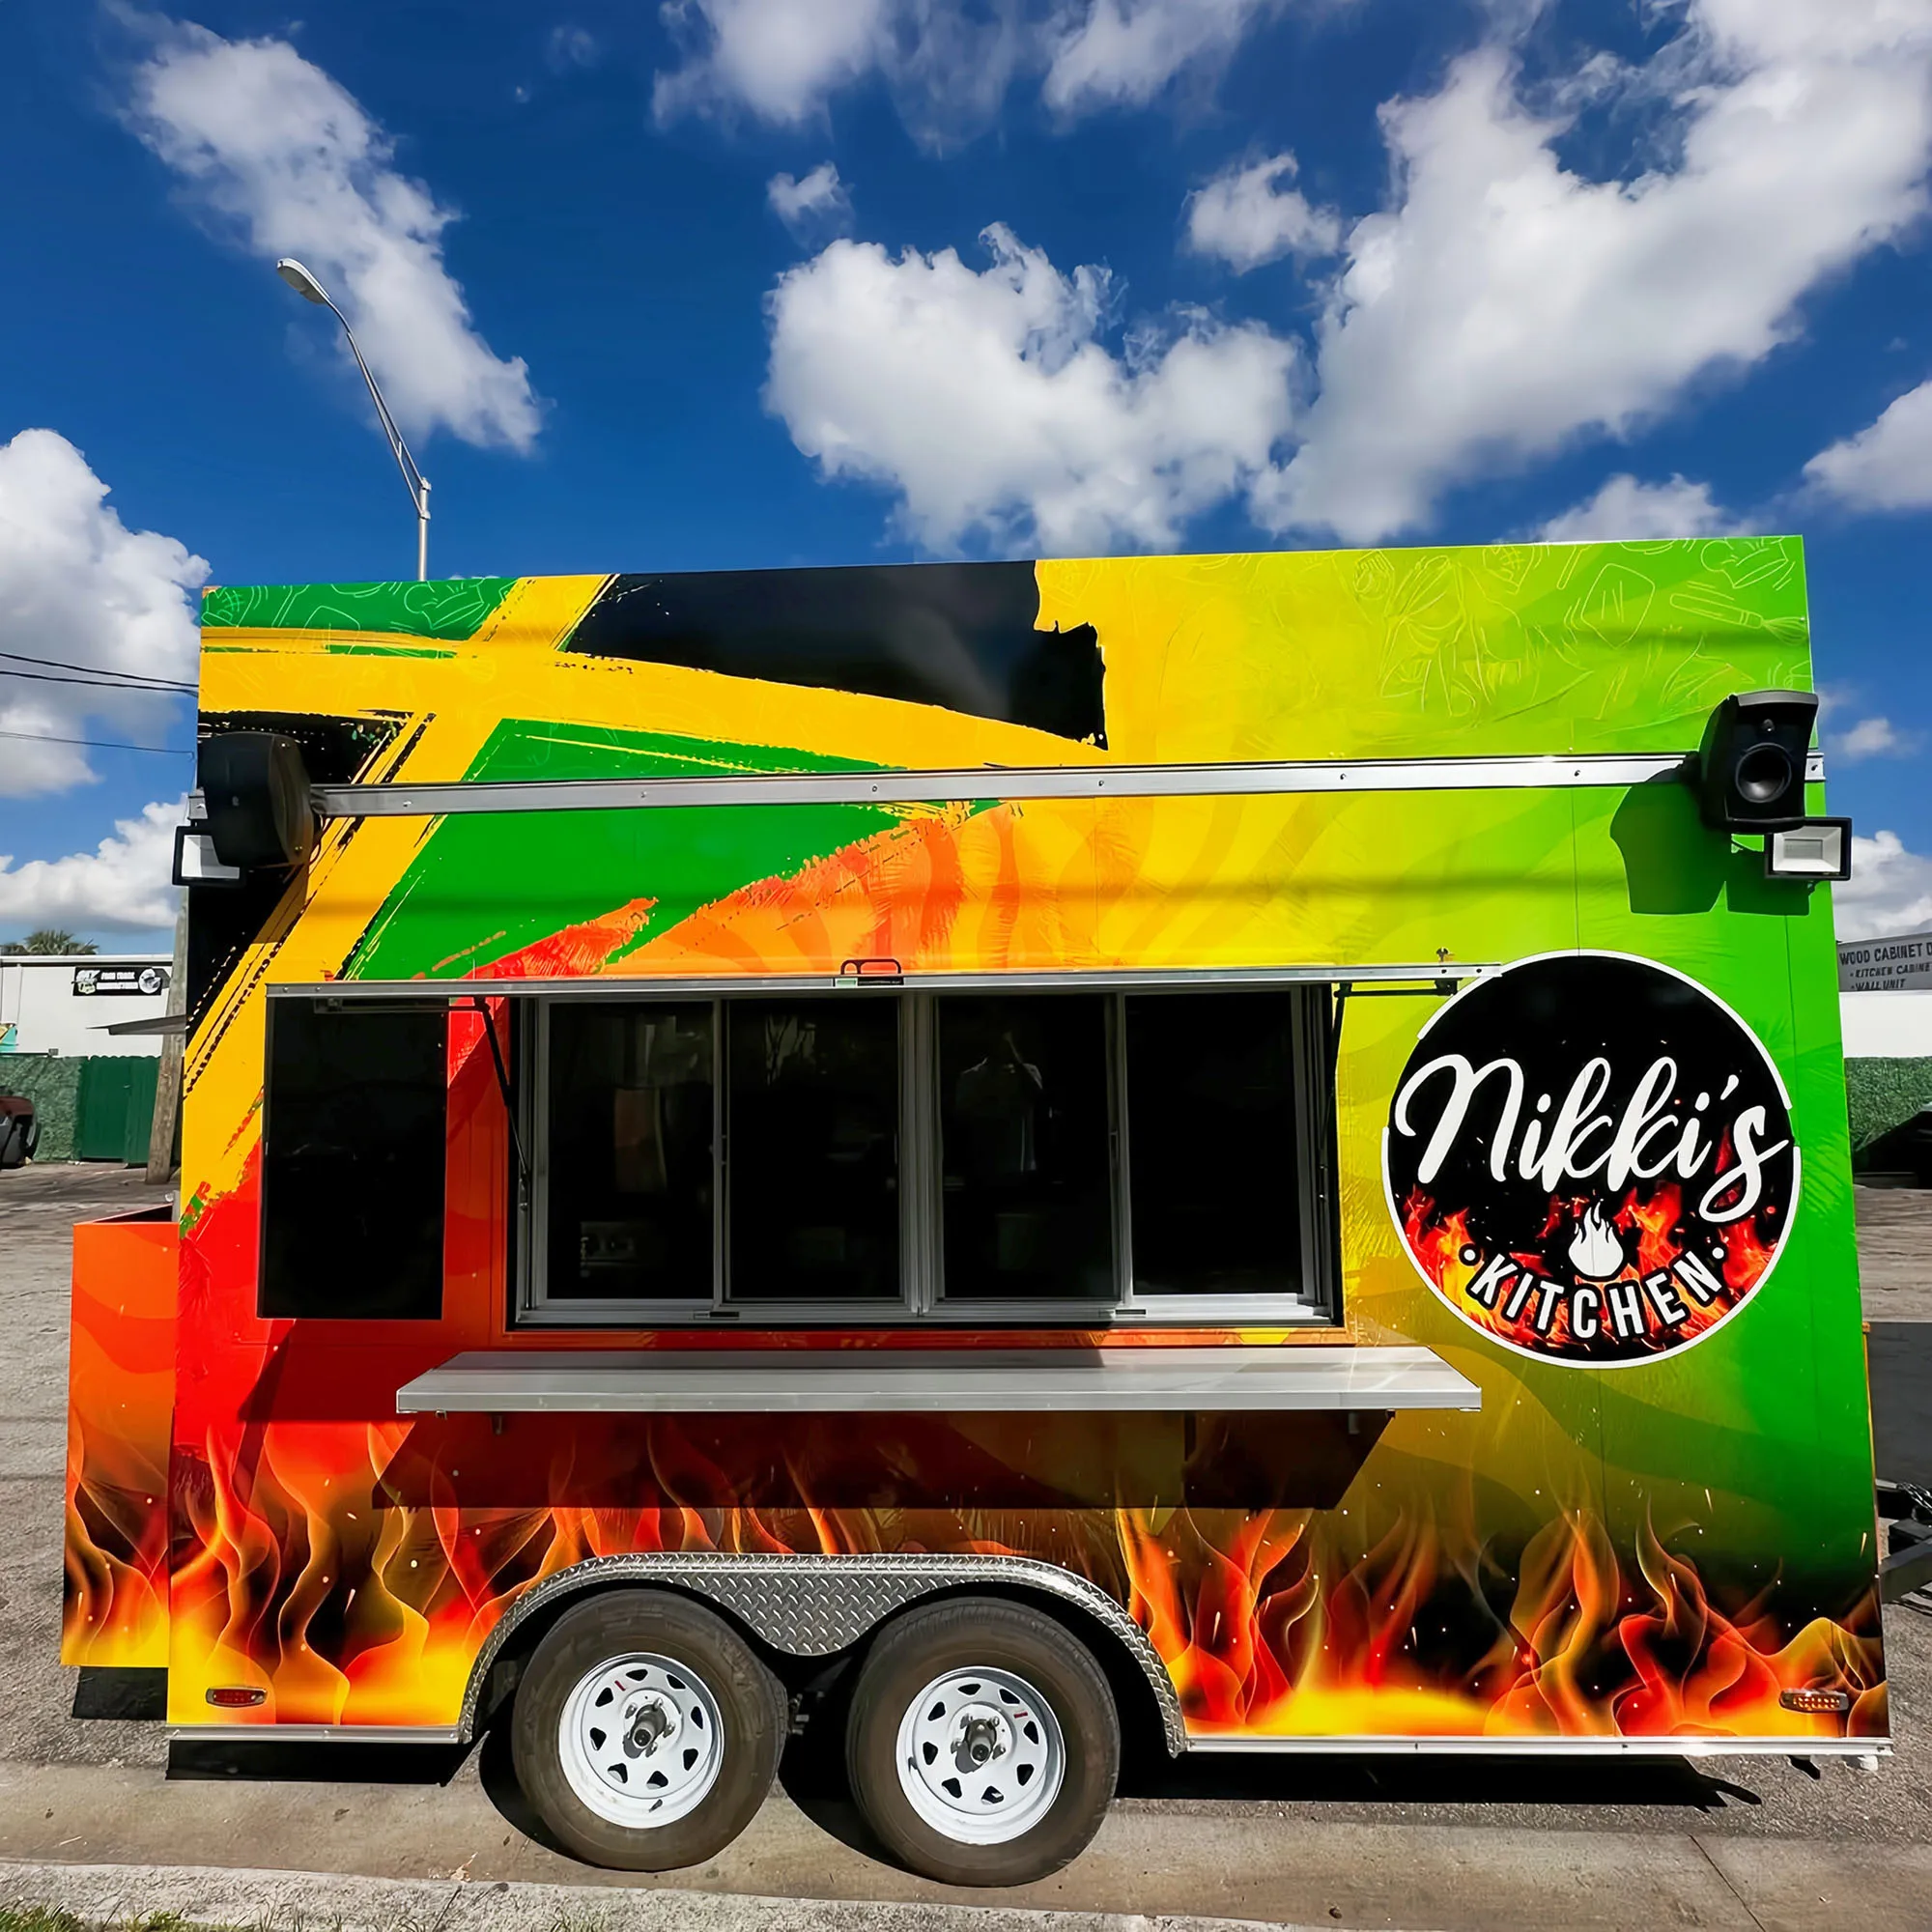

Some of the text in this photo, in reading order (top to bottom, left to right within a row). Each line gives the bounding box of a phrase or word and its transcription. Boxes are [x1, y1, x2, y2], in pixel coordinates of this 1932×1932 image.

[1839, 950, 1871, 965] WOOD
[1874, 943, 1923, 962] CABINET
[1883, 979, 1906, 990] UNIT
[1395, 1054, 1789, 1223] Nikki's
[1470, 1251, 1722, 1338] KITCHEN
